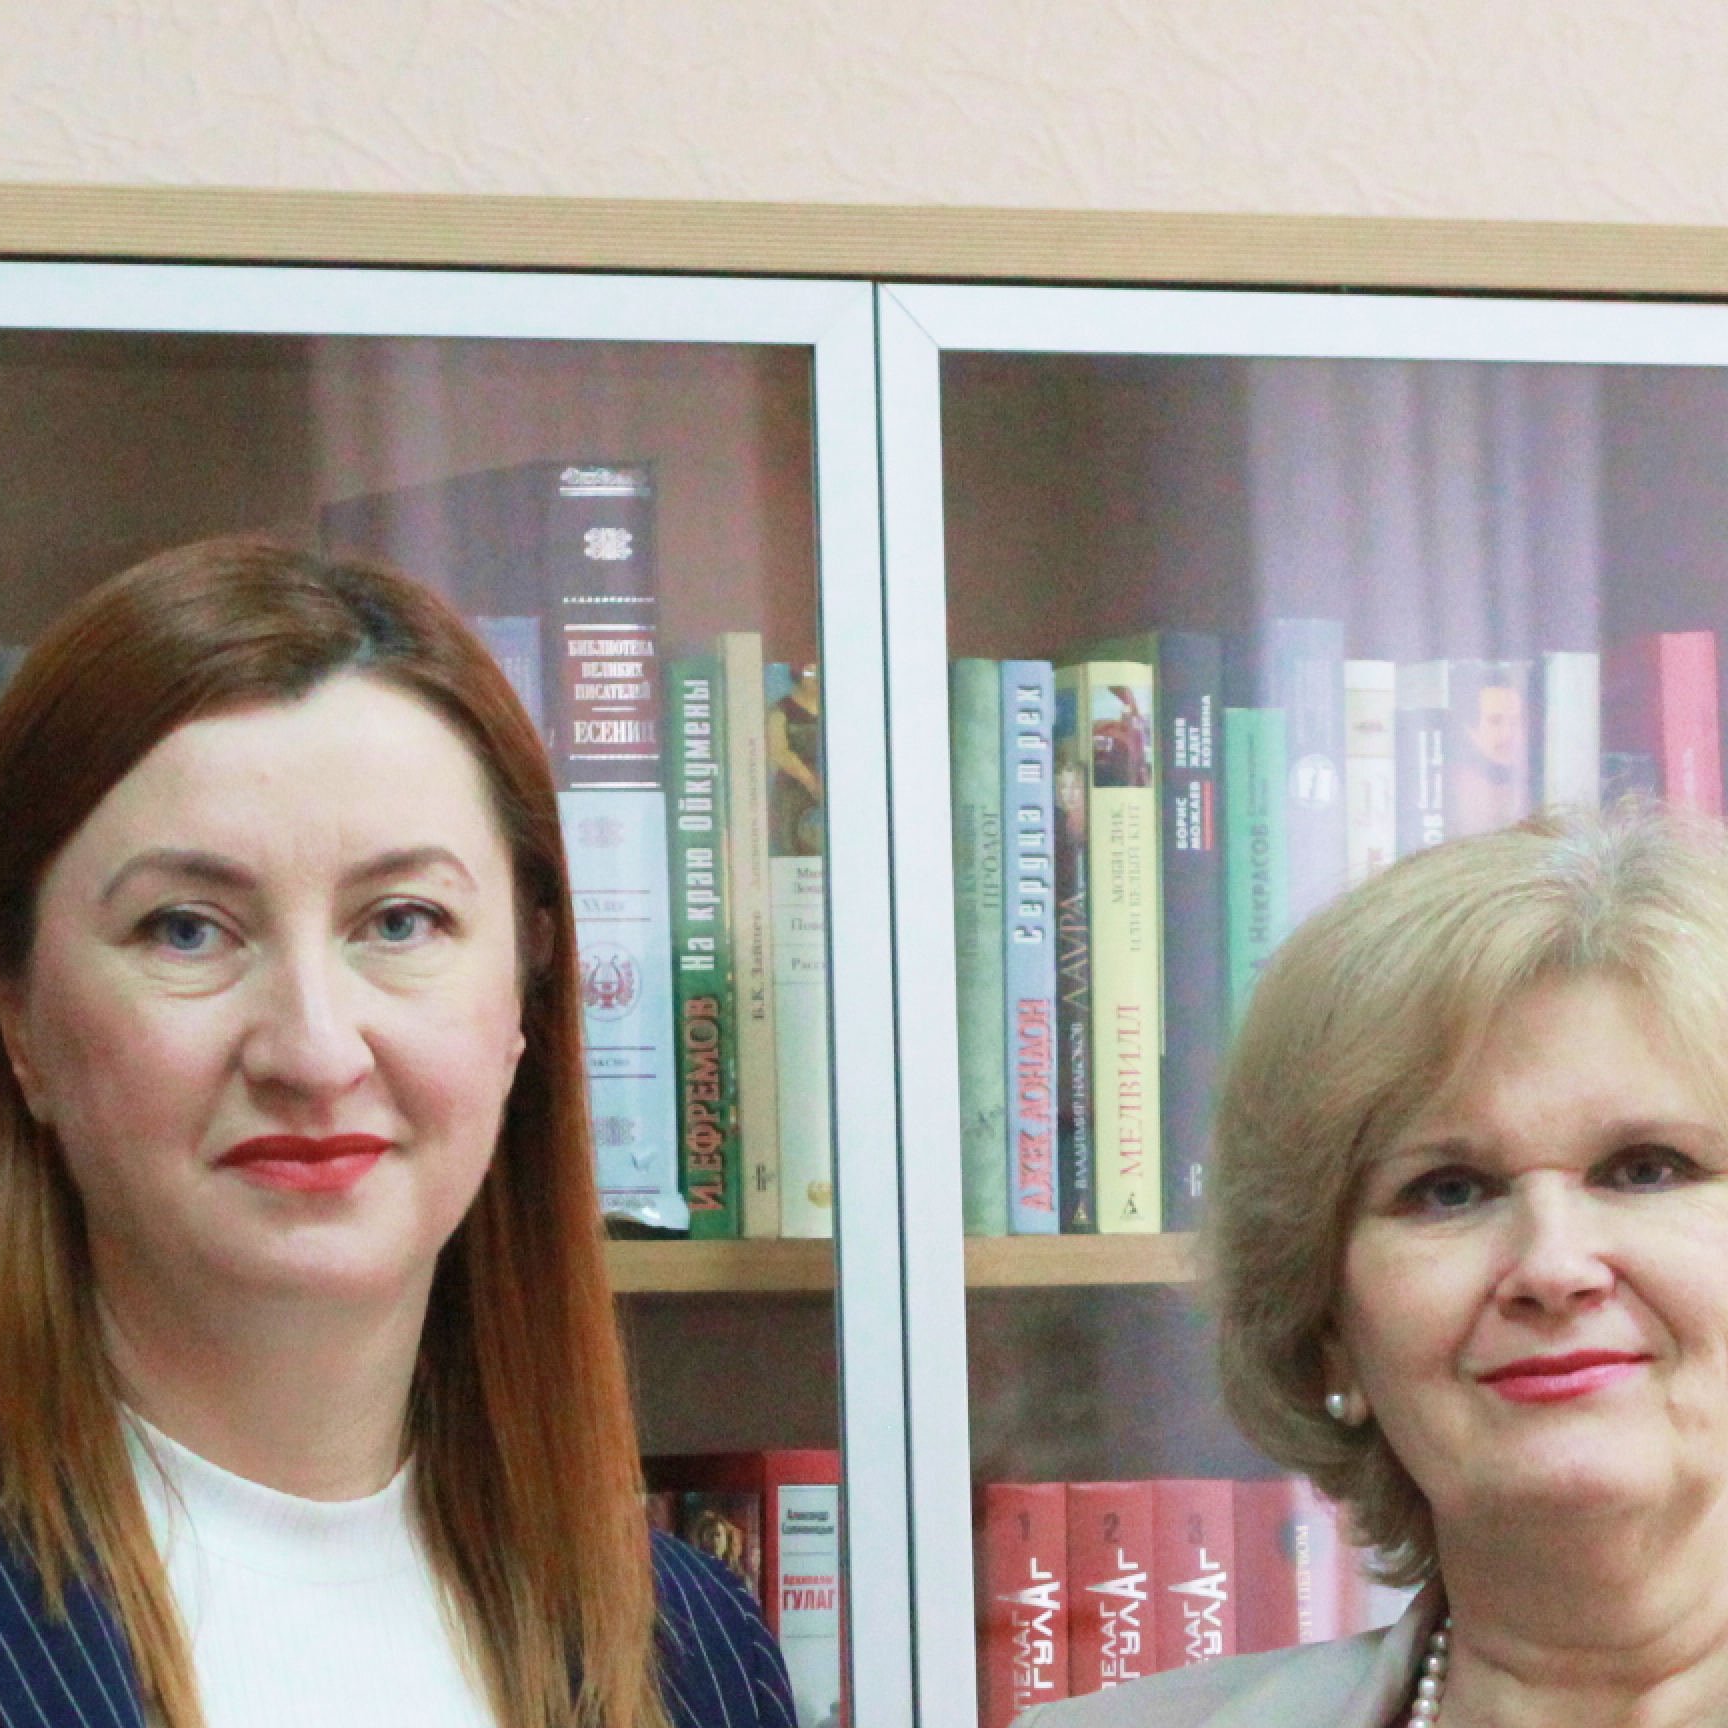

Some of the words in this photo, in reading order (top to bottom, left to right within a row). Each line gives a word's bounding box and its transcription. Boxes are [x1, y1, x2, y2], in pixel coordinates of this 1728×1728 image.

[574, 719, 656, 744] ЕСЕНИН
[678, 679, 719, 831] Ойкумены
[1175, 717, 1187, 769] ЗЕМЛЯ
[1188, 725, 1201, 769] ЖДЕТ
[1125, 802, 1141, 841] КИТ
[1176, 797, 1188, 851] БОРИС
[1189, 781, 1202, 851] МОЖАЕВ
[685, 847, 720, 921] краю
[980, 806, 999, 909] ПРОЛОГ
[1012, 804, 1051, 945] Сердца
[1110, 851, 1125, 904] МОБИ
[680, 937, 715, 970] На
[1015, 998, 1052, 1126] ЛОНДОН
[1115, 1003, 1145, 1179] МЕЛВИЛЛ
[1017, 1130, 1055, 1214] ДЖЕК
[1017, 1511, 1032, 1541] 1
[1101, 1512, 1121, 1544] 2
[1187, 1511, 1204, 1545] 3
[783, 1589, 837, 1611] ГУЛАГ
[996, 1557, 1061, 1690] ГУЛАГ
[1084, 1547, 1148, 1680] ГУЛАГ
[1167, 1547, 1228, 1662] УЛАГ
